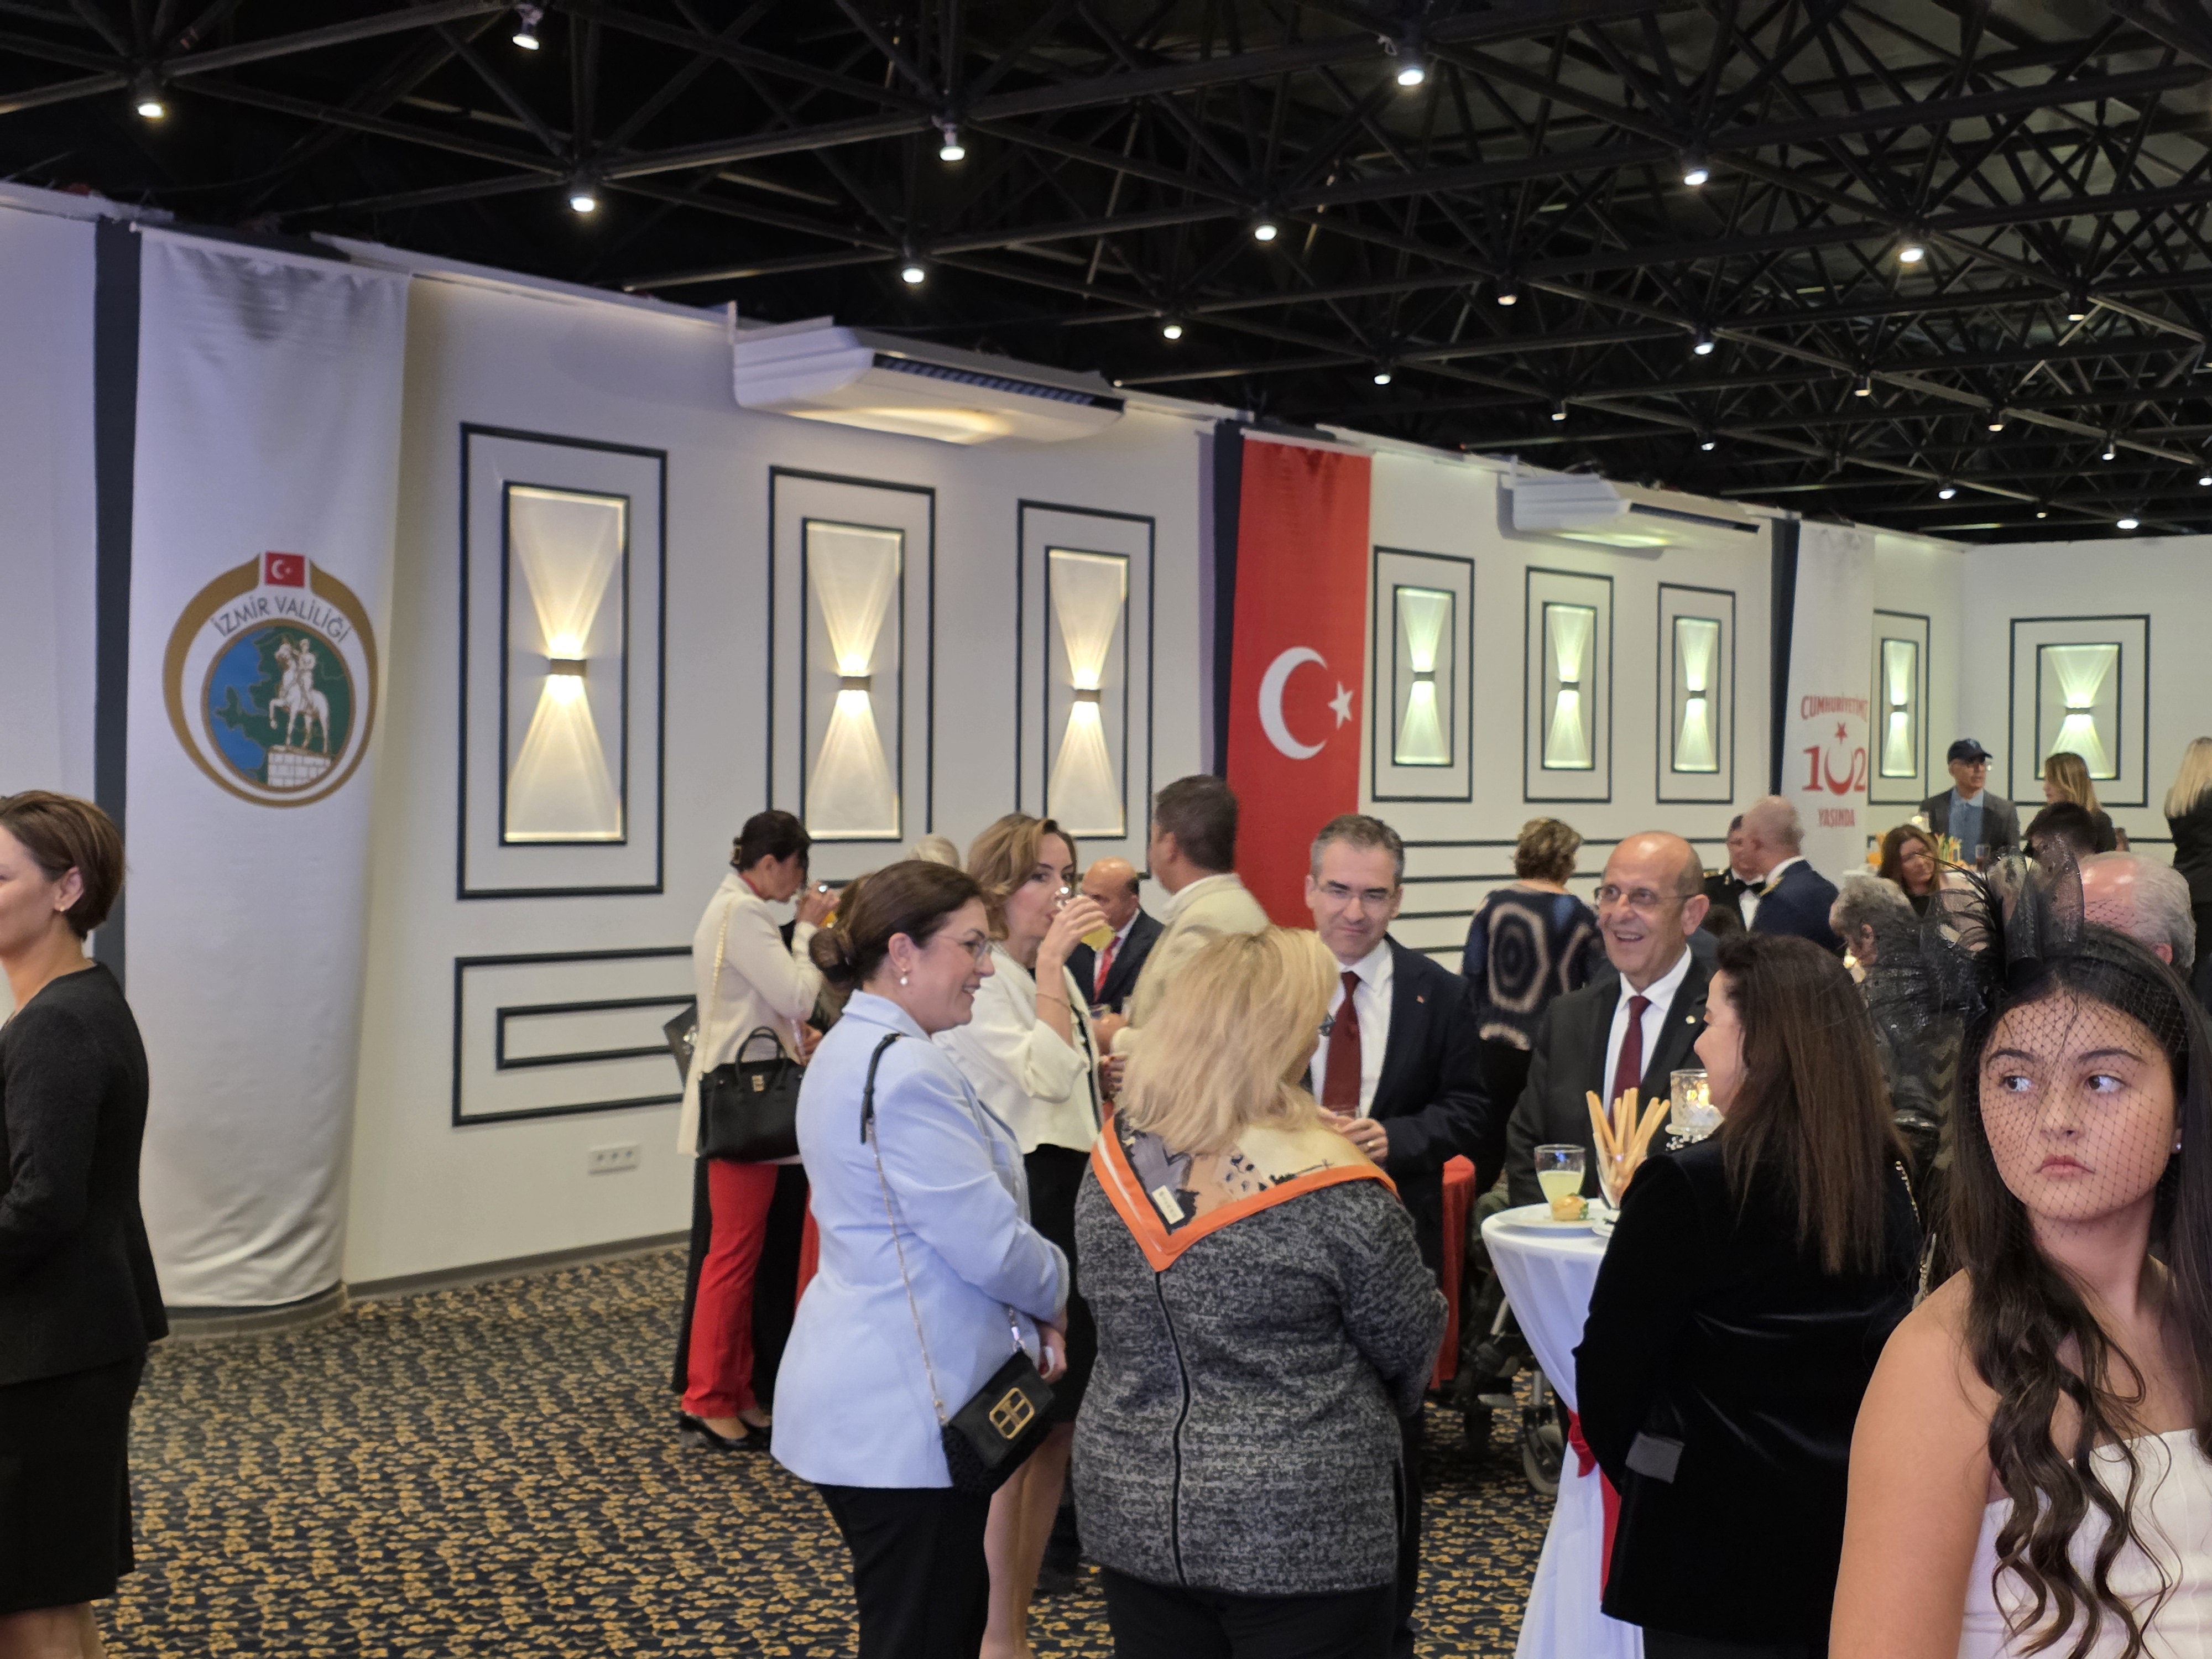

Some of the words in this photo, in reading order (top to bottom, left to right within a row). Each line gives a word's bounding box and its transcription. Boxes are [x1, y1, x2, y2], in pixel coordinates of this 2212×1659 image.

[210, 595, 270, 637] İZMİR
[274, 596, 351, 643] VALİLİĞİ
[1802, 745, 1866, 796] 102
